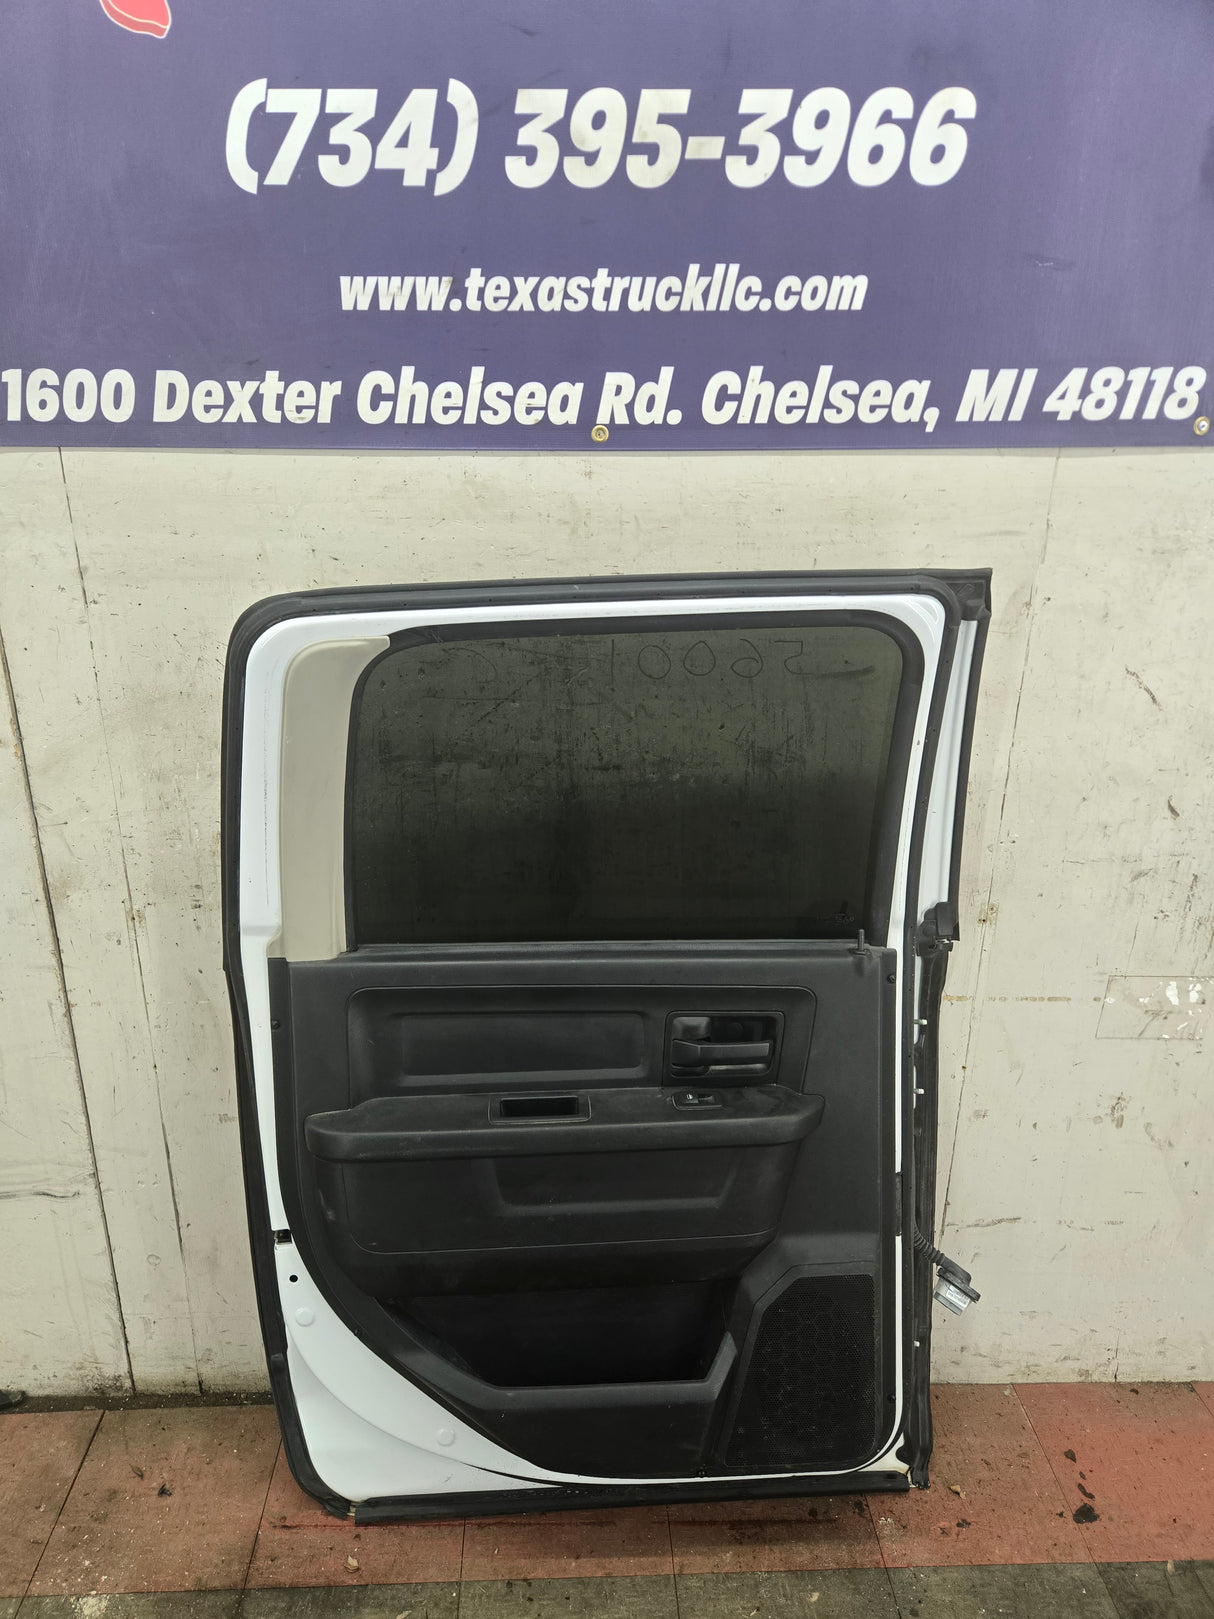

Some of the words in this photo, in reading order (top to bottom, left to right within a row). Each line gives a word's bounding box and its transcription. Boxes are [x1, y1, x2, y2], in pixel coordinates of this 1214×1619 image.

[226, 78, 478, 196] (734)
[505, 87, 977, 188] 395-3966
[340, 263, 868, 312] www.texastruckllc.com
[1, 368, 136, 423] 1600
[153, 370, 342, 424] Dexter
[357, 366, 584, 425] Chelsea
[596, 366, 682, 425] Rd.
[702, 365, 939, 432] Chelsea,
[955, 368, 1038, 422] MI
[1042, 366, 1207, 421] 48118
